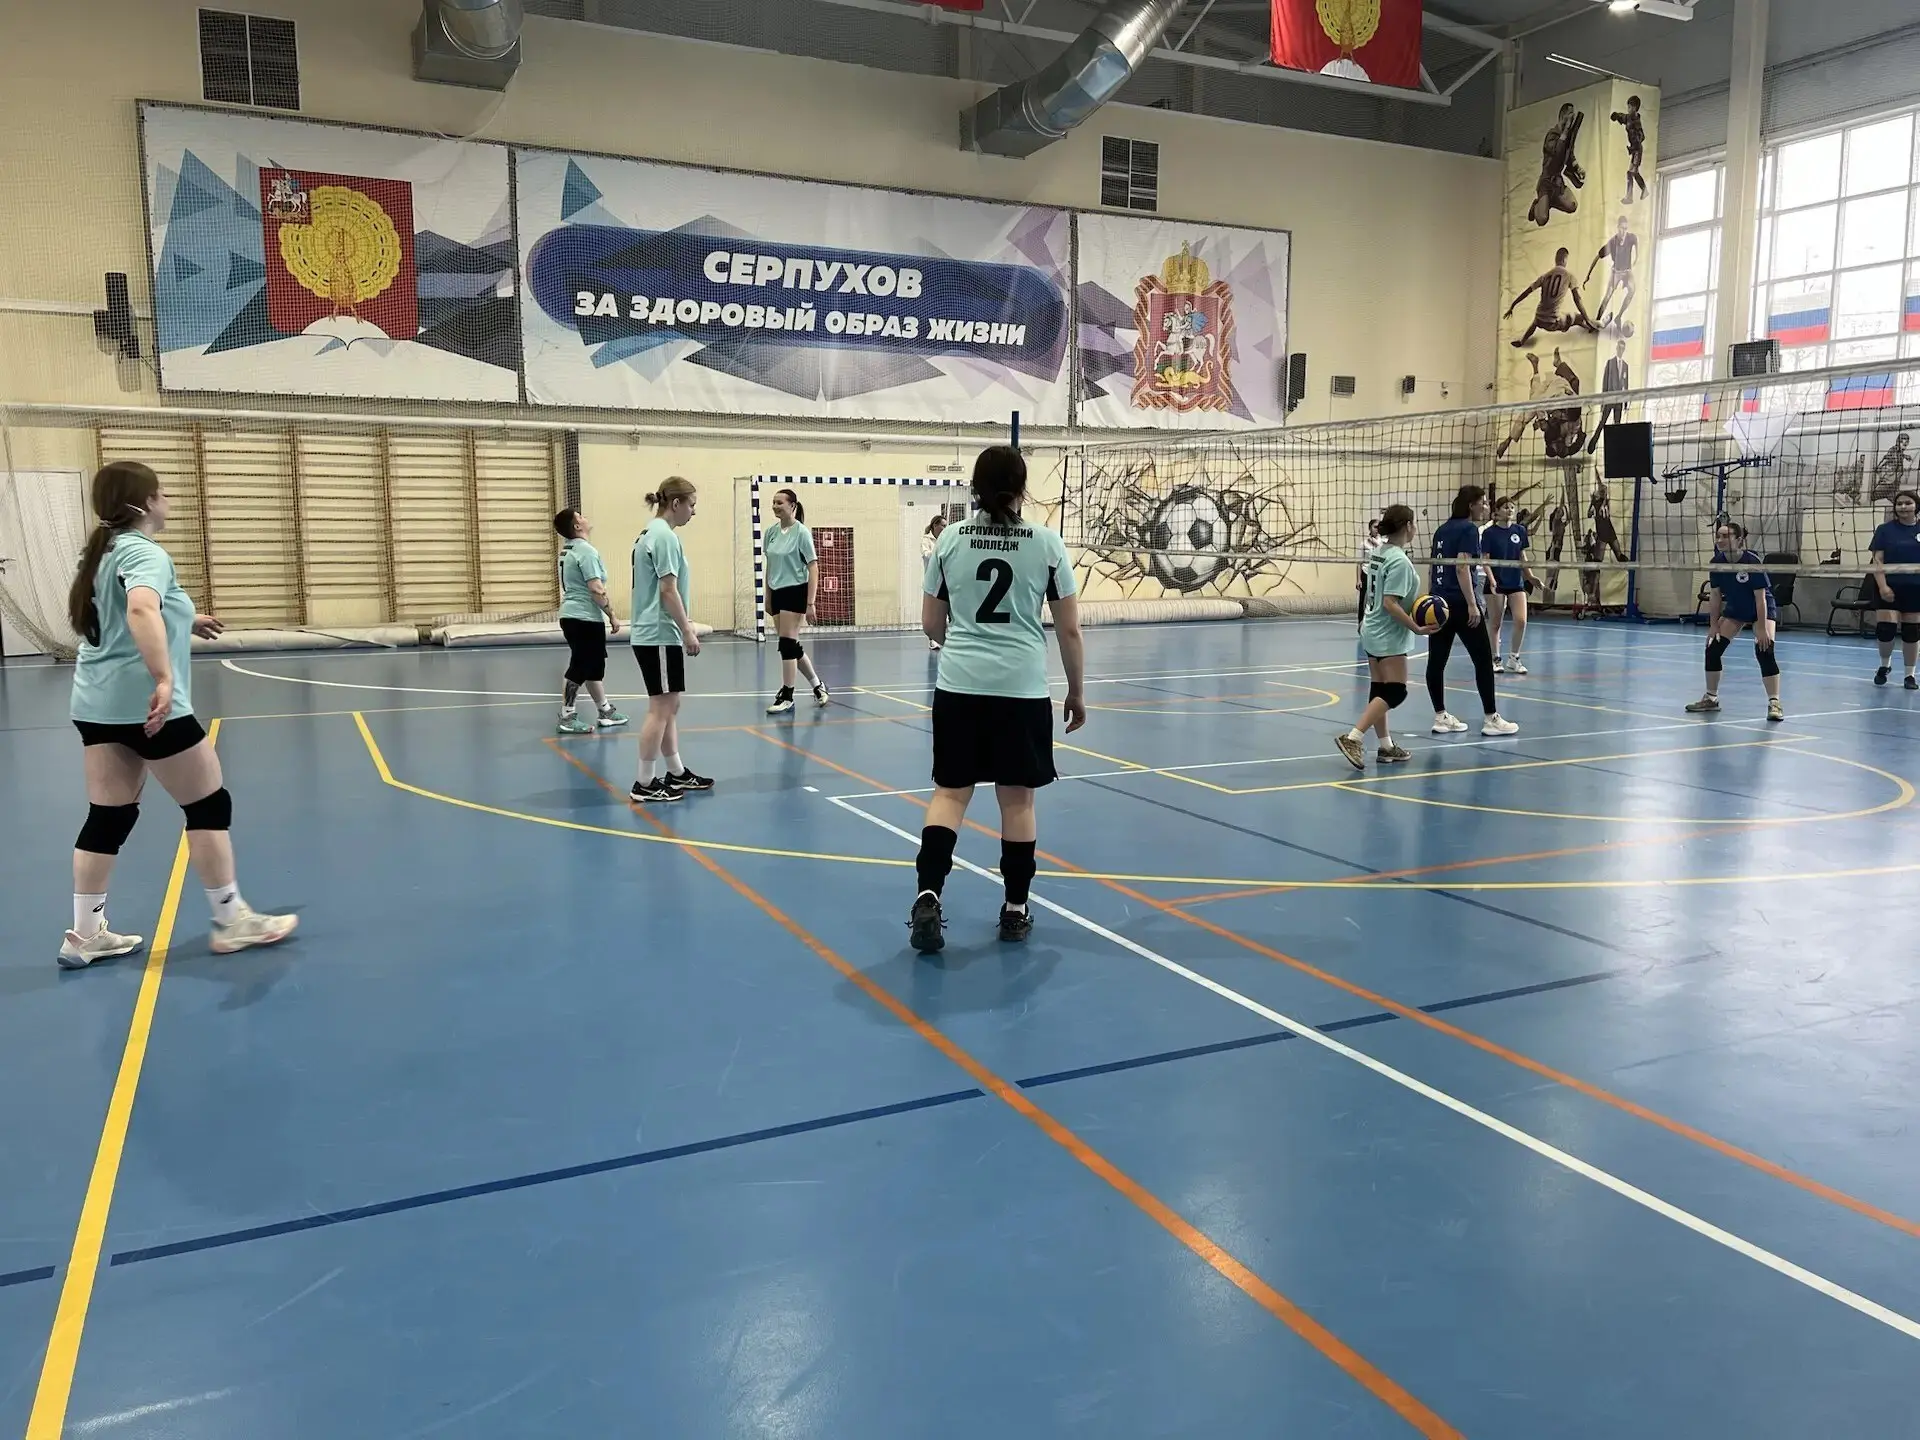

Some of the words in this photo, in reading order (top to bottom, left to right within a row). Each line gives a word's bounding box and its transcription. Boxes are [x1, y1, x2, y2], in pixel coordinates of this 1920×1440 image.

[703, 251, 922, 298] СЕРПУХОВ
[574, 290, 619, 318] ЗА
[629, 295, 816, 331] ЗДОРОВЫЙ
[824, 310, 919, 338] ОБРАЗ
[926, 317, 1026, 346] ЖИЗНИ
[958, 525, 1033, 538] СЕРПУХОВСКИЙ
[970, 539, 1019, 552] КОЛЛЕДЖ
[976, 558, 1013, 623] 2
